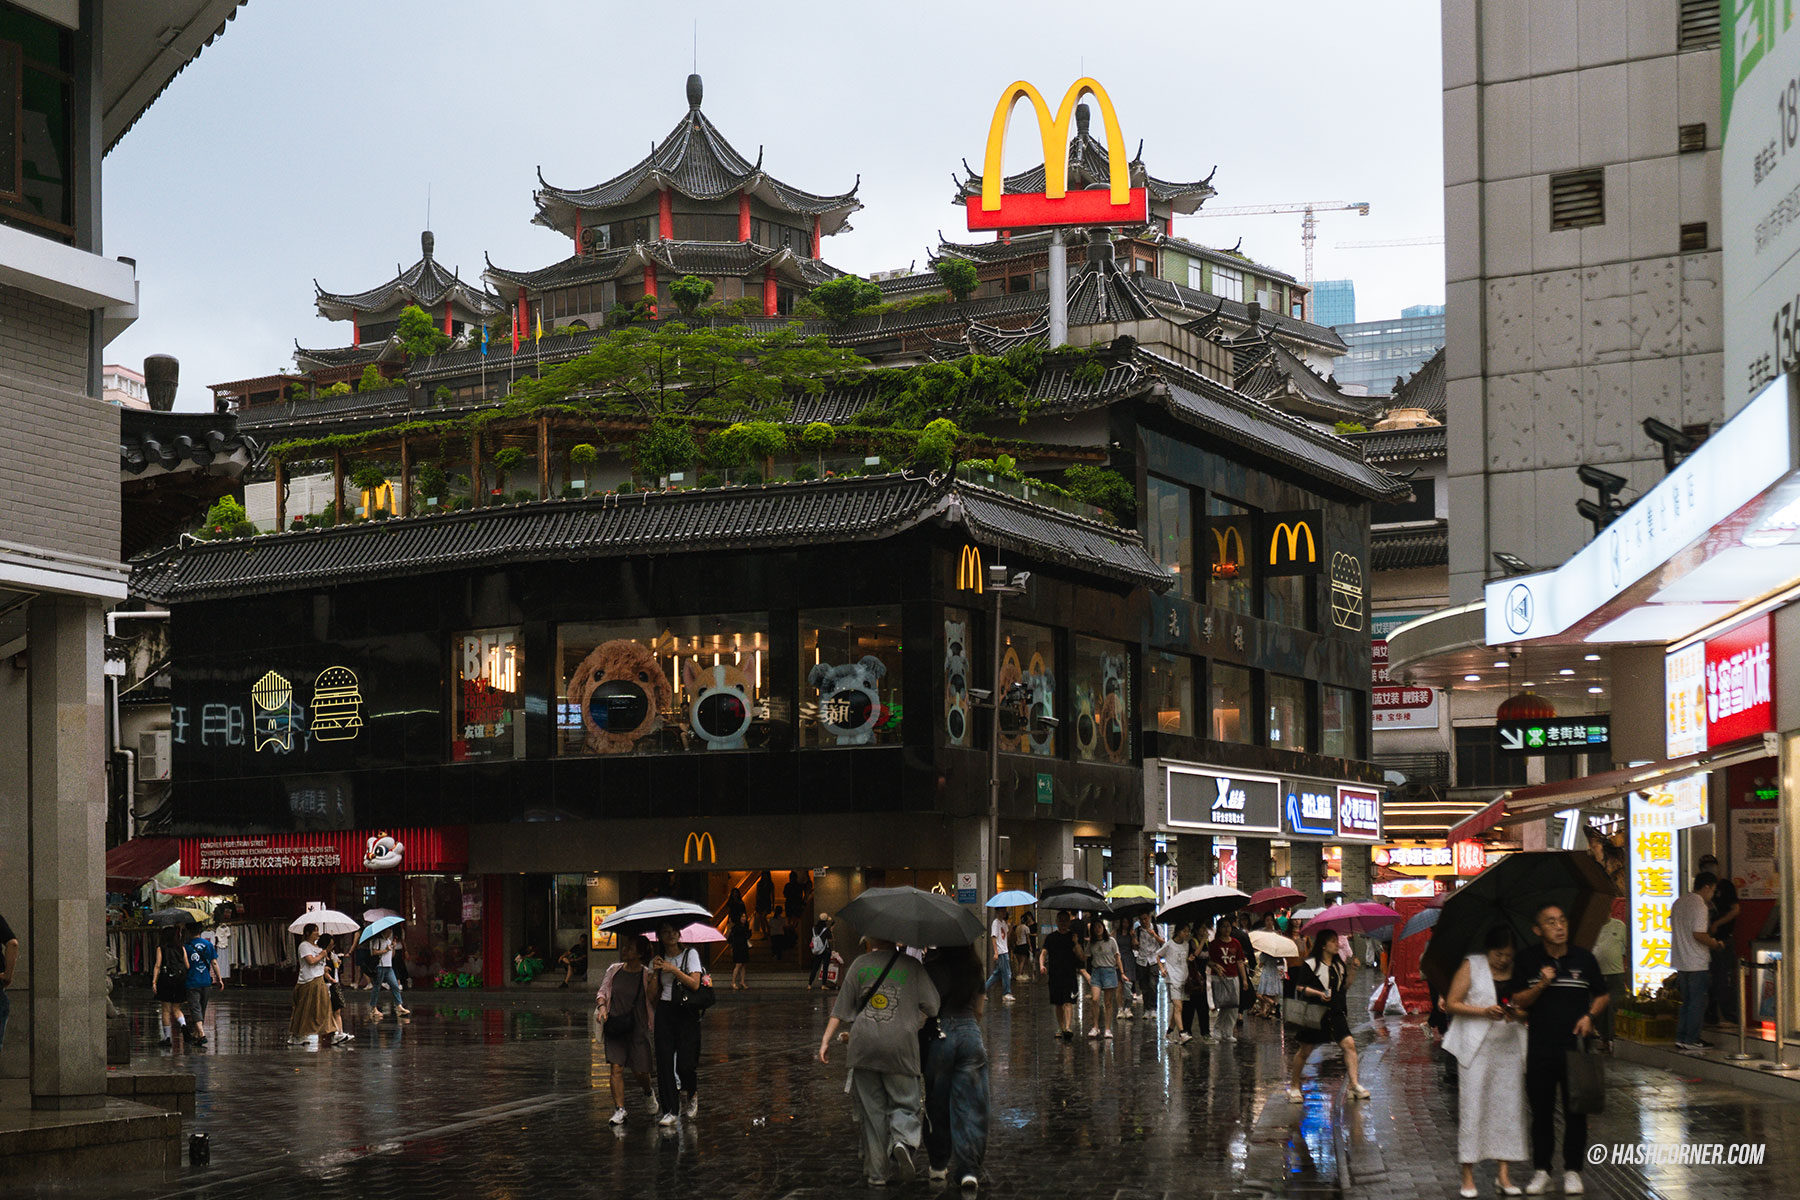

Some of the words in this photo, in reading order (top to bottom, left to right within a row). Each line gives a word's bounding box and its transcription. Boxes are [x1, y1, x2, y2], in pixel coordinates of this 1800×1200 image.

[464, 693, 504, 708] FRIENDS
[464, 707, 505, 722] FOREVER
[1547, 725, 1587, 740] 老街站
[1637, 831, 1672, 968] 榴莲批发
